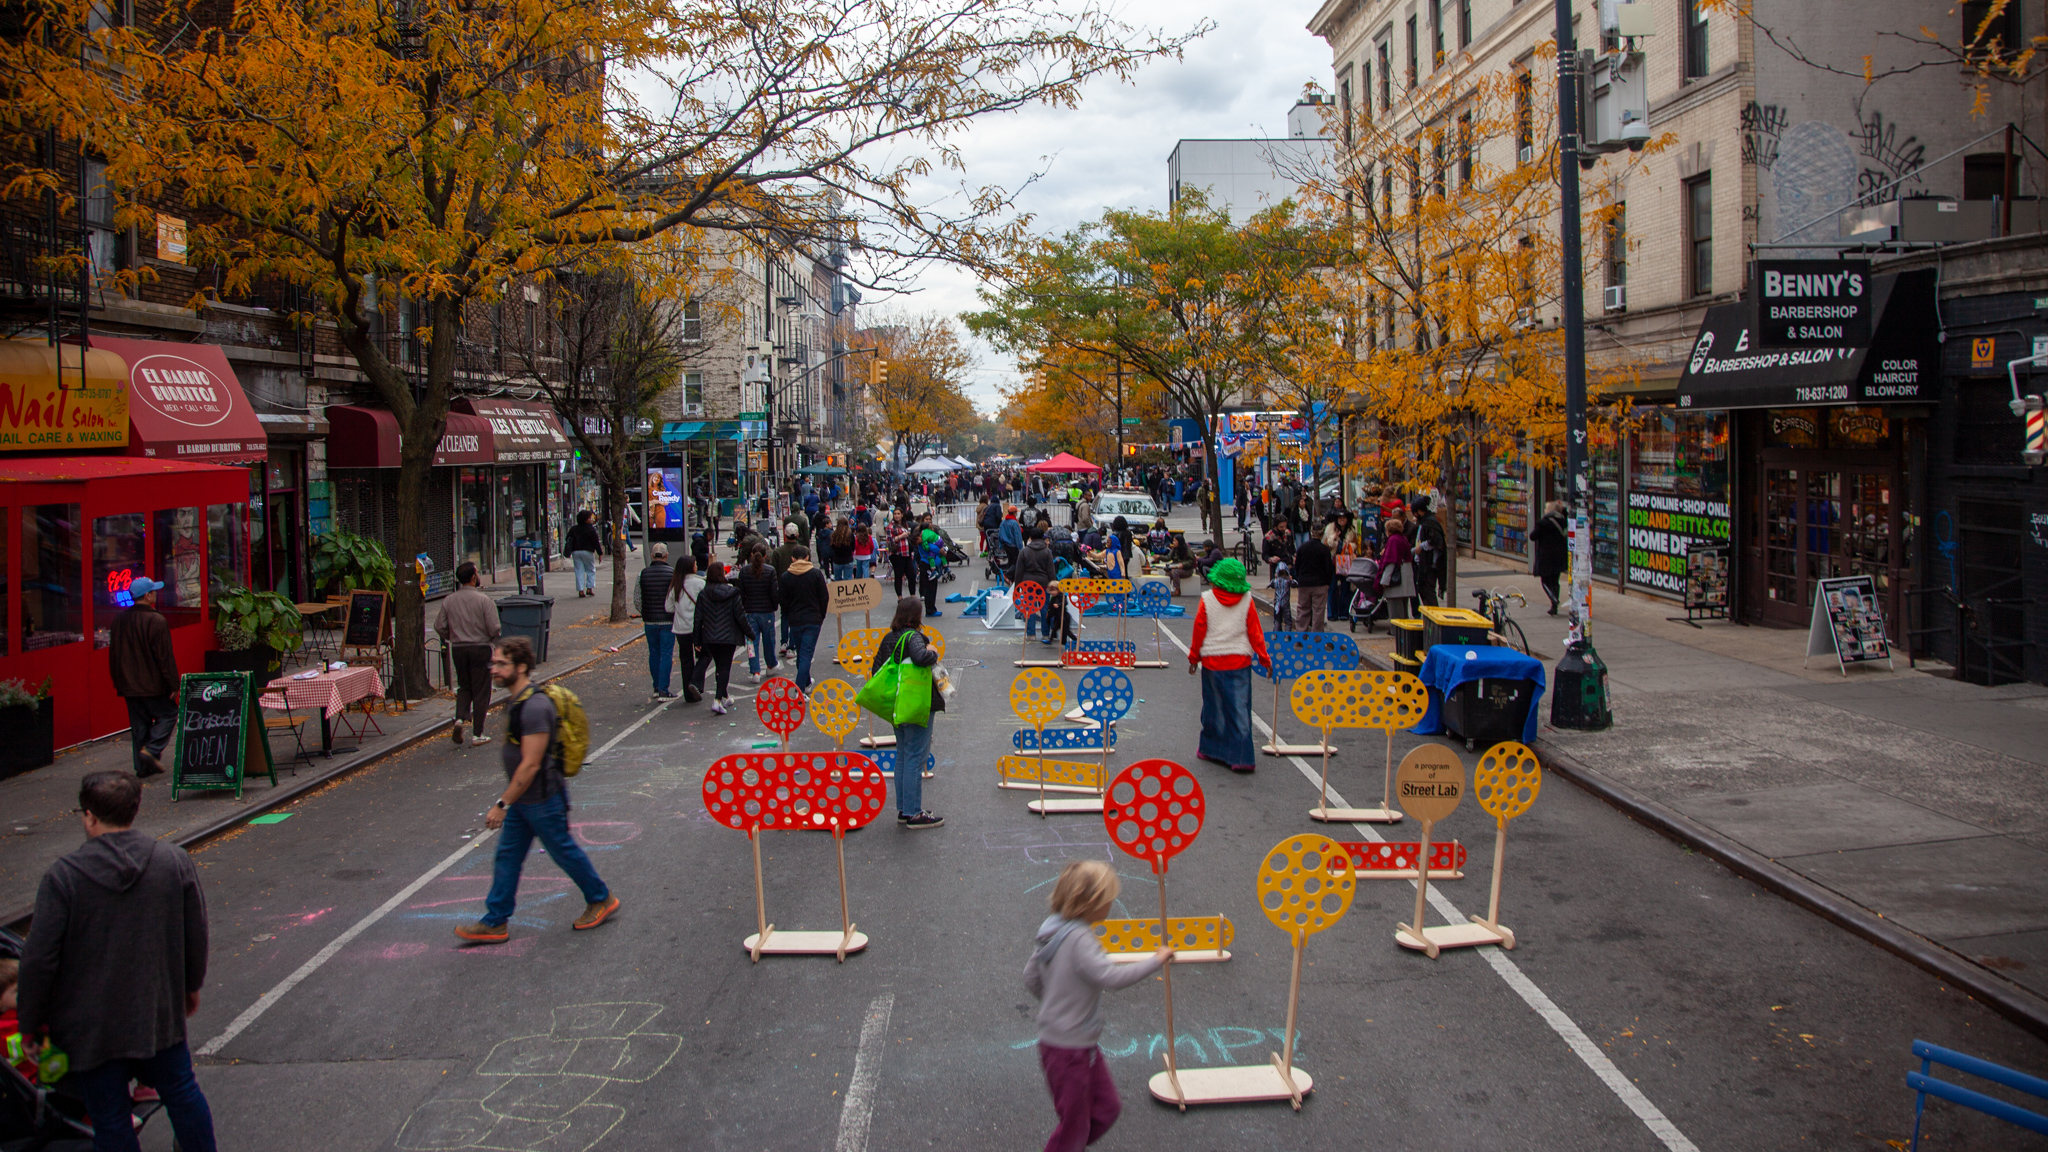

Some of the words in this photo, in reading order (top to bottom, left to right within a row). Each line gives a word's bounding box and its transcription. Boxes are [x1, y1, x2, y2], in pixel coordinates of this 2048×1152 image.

[1764, 270, 1863, 297] BENNY'S
[1770, 305, 1858, 319] BARBERSHOP
[1787, 326, 1797, 339] &
[1799, 326, 1843, 338] SALON
[1703, 356, 1780, 374] BARBERSHOP
[1778, 354, 1789, 367] &
[1788, 348, 1834, 365] SALON
[1882, 359, 1918, 370] COLOR
[141, 368, 163, 384] EL
[160, 369, 210, 386] BARRIO
[1874, 372, 1919, 383] HAIRCUT
[150, 385, 218, 402] BURRITOS
[1796, 386, 1848, 401] 718-637-1200
[1865, 385, 1919, 396] BLOW-DRY
[0, 382, 69, 429] Nail
[1680, 395, 1691, 407] 809
[72, 406, 104, 428] Salon
[1229, 414, 1253, 432] BIG
[1840, 416, 1880, 434] GELATO
[486, 418, 512, 435] ALES
[1773, 417, 1815, 435] ESPRESSO
[28, 432, 61, 443] CARE
[66, 432, 73, 443] &
[79, 431, 122, 442] WAXING
[446, 435, 479, 452] CLEANERS
[1629, 493, 1650, 508] SHOP
[1650, 495, 1680, 512] ONLINE
[1682, 499, 1706, 515] SHOP
[1629, 527, 1669, 553] HOME
[1629, 566, 1651, 583] SHOP
[1651, 571, 1680, 591] LOCAL
[837, 583, 867, 597] PLAY
[203, 685, 227, 702] CYNAR
[189, 734, 228, 767] OPEN
[1420, 763, 1450, 771] program
[1403, 783, 1436, 796] Street
[1438, 784, 1458, 797] Lab
